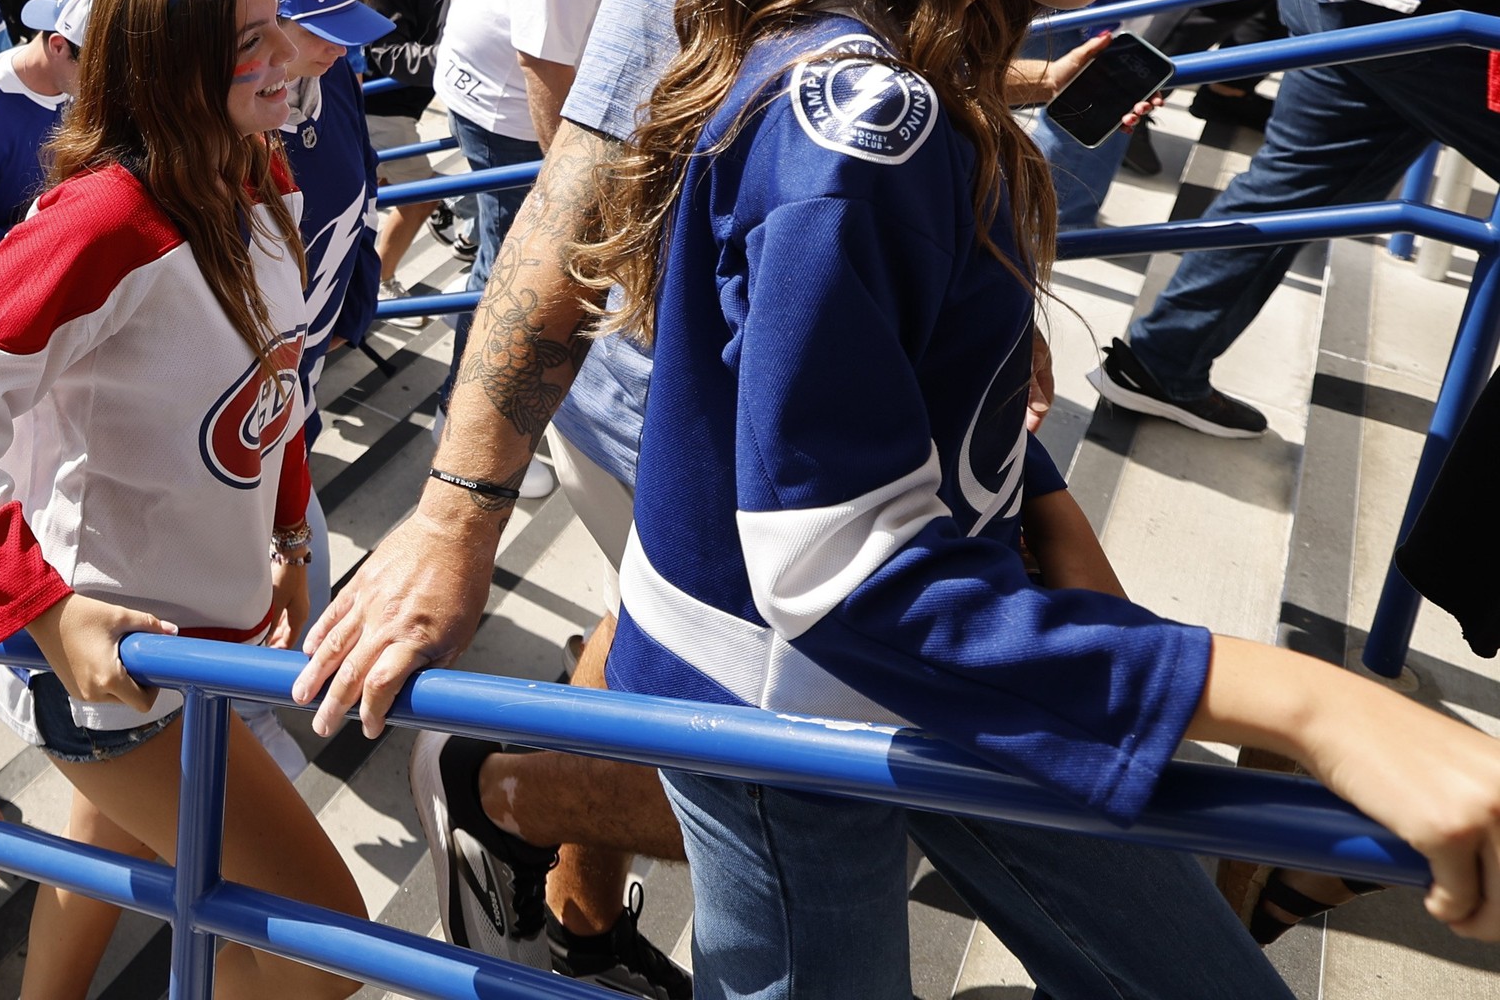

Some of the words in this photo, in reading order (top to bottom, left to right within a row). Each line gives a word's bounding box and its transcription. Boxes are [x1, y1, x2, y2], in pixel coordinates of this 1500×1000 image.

[445, 59, 482, 102] TBL
[806, 65, 831, 131] TAMPA
[851, 128, 888, 143] HOCKEY
[858, 138, 882, 150] CLUB
[488, 890, 504, 928] BROOKS
